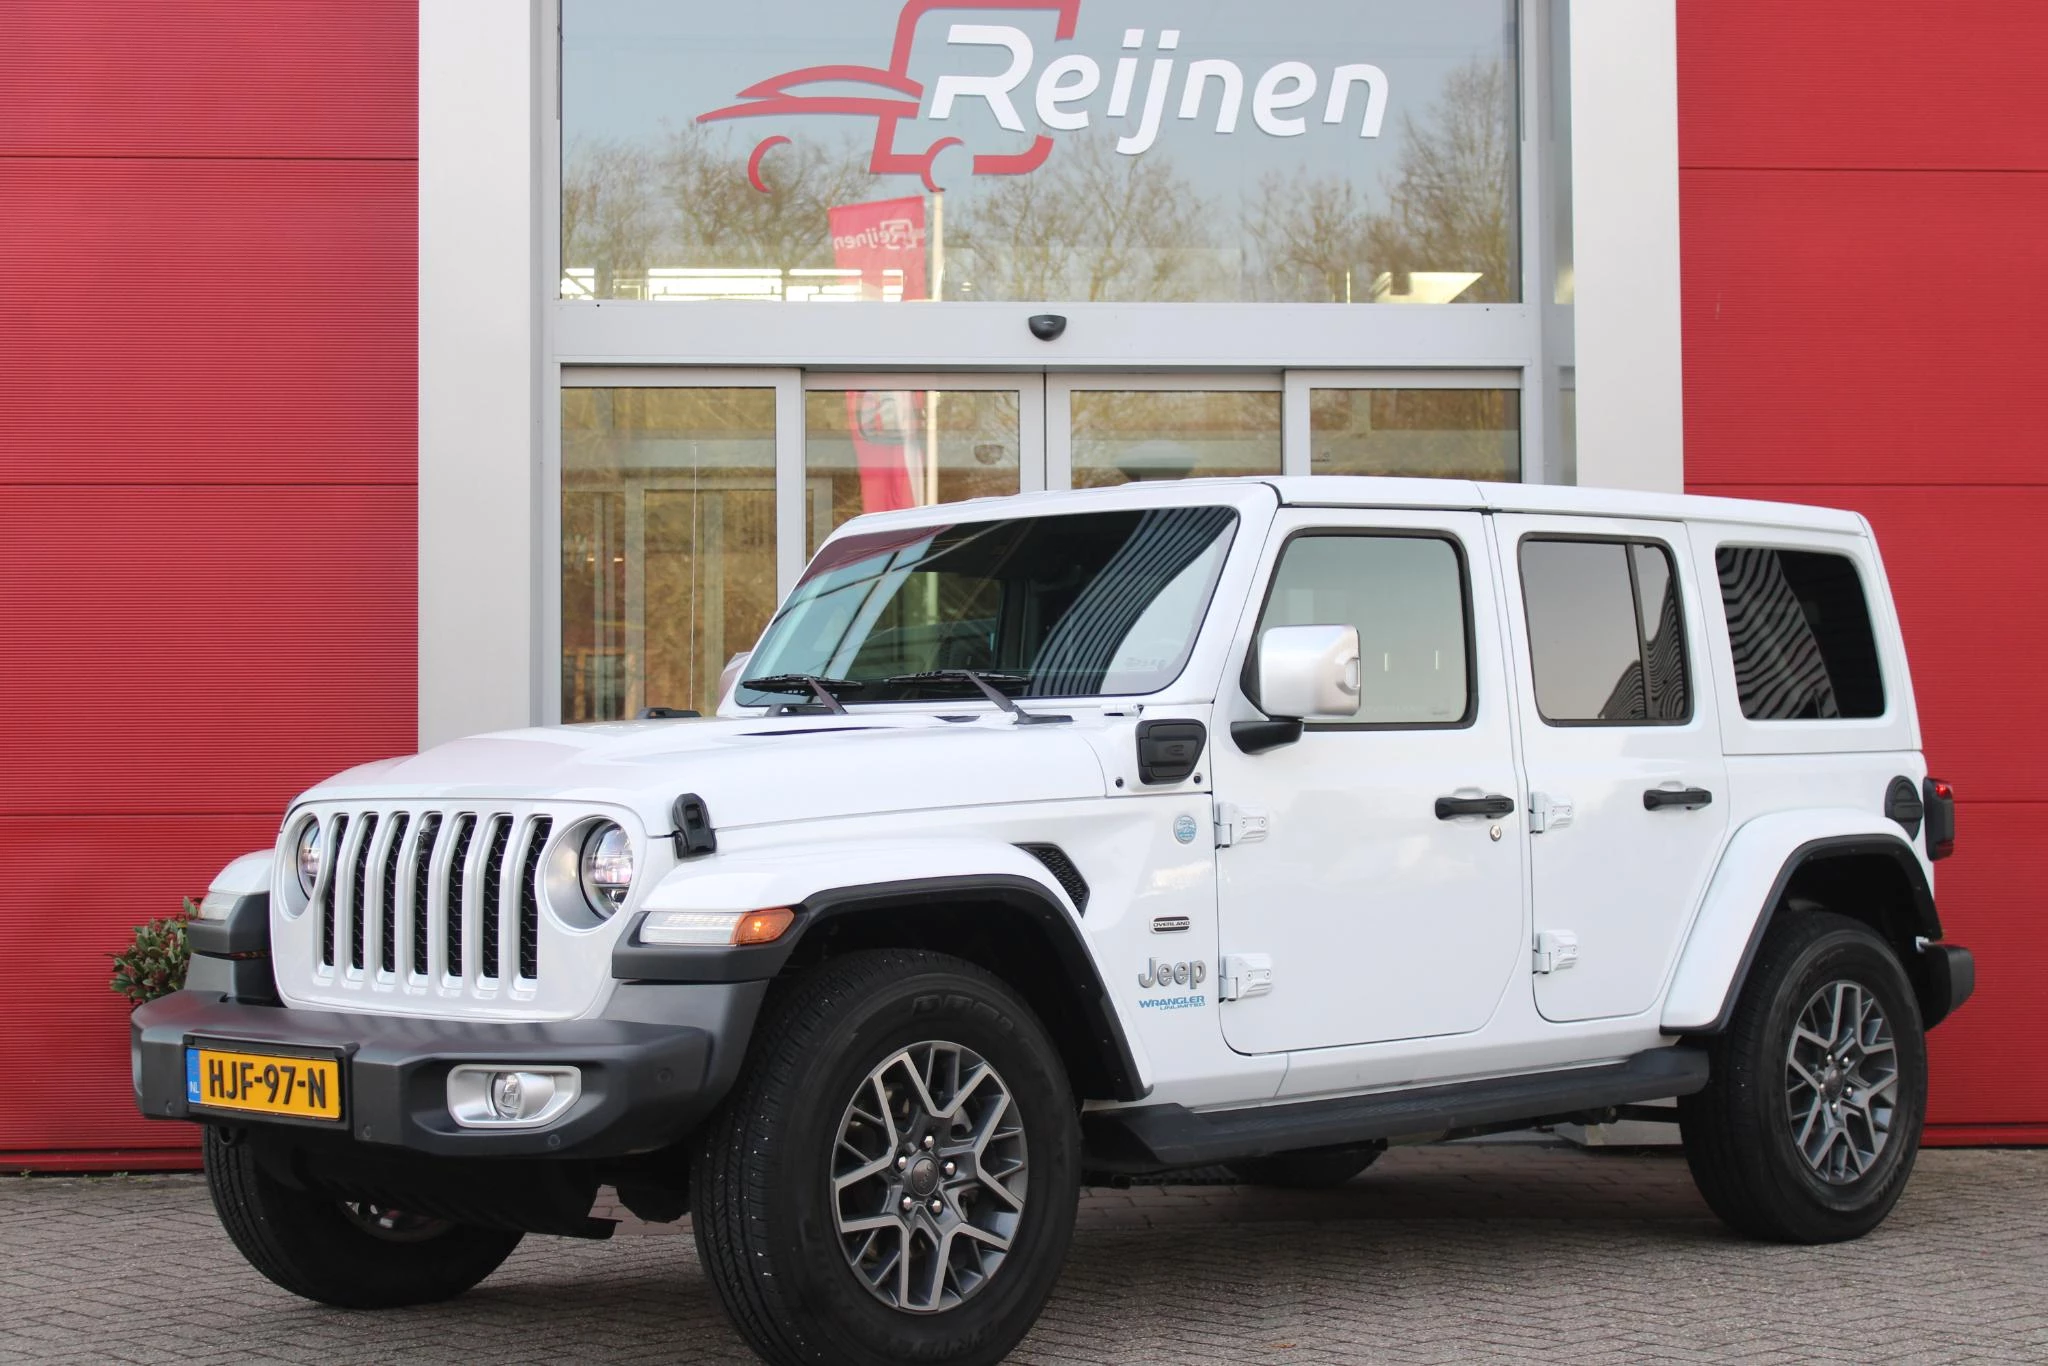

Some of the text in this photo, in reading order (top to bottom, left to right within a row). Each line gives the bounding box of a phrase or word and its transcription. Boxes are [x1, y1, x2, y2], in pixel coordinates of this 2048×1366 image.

[928, 23, 1390, 156] Reijnen
[1153, 920, 1190, 928] OVERLAND
[1138, 957, 1206, 989] Jeep
[1139, 995, 1205, 1009] WRANGLER
[1160, 1001, 1206, 1011] UNLIMITED
[189, 1080, 200, 1094] NL
[209, 1059, 327, 1109] HJF-97-N
